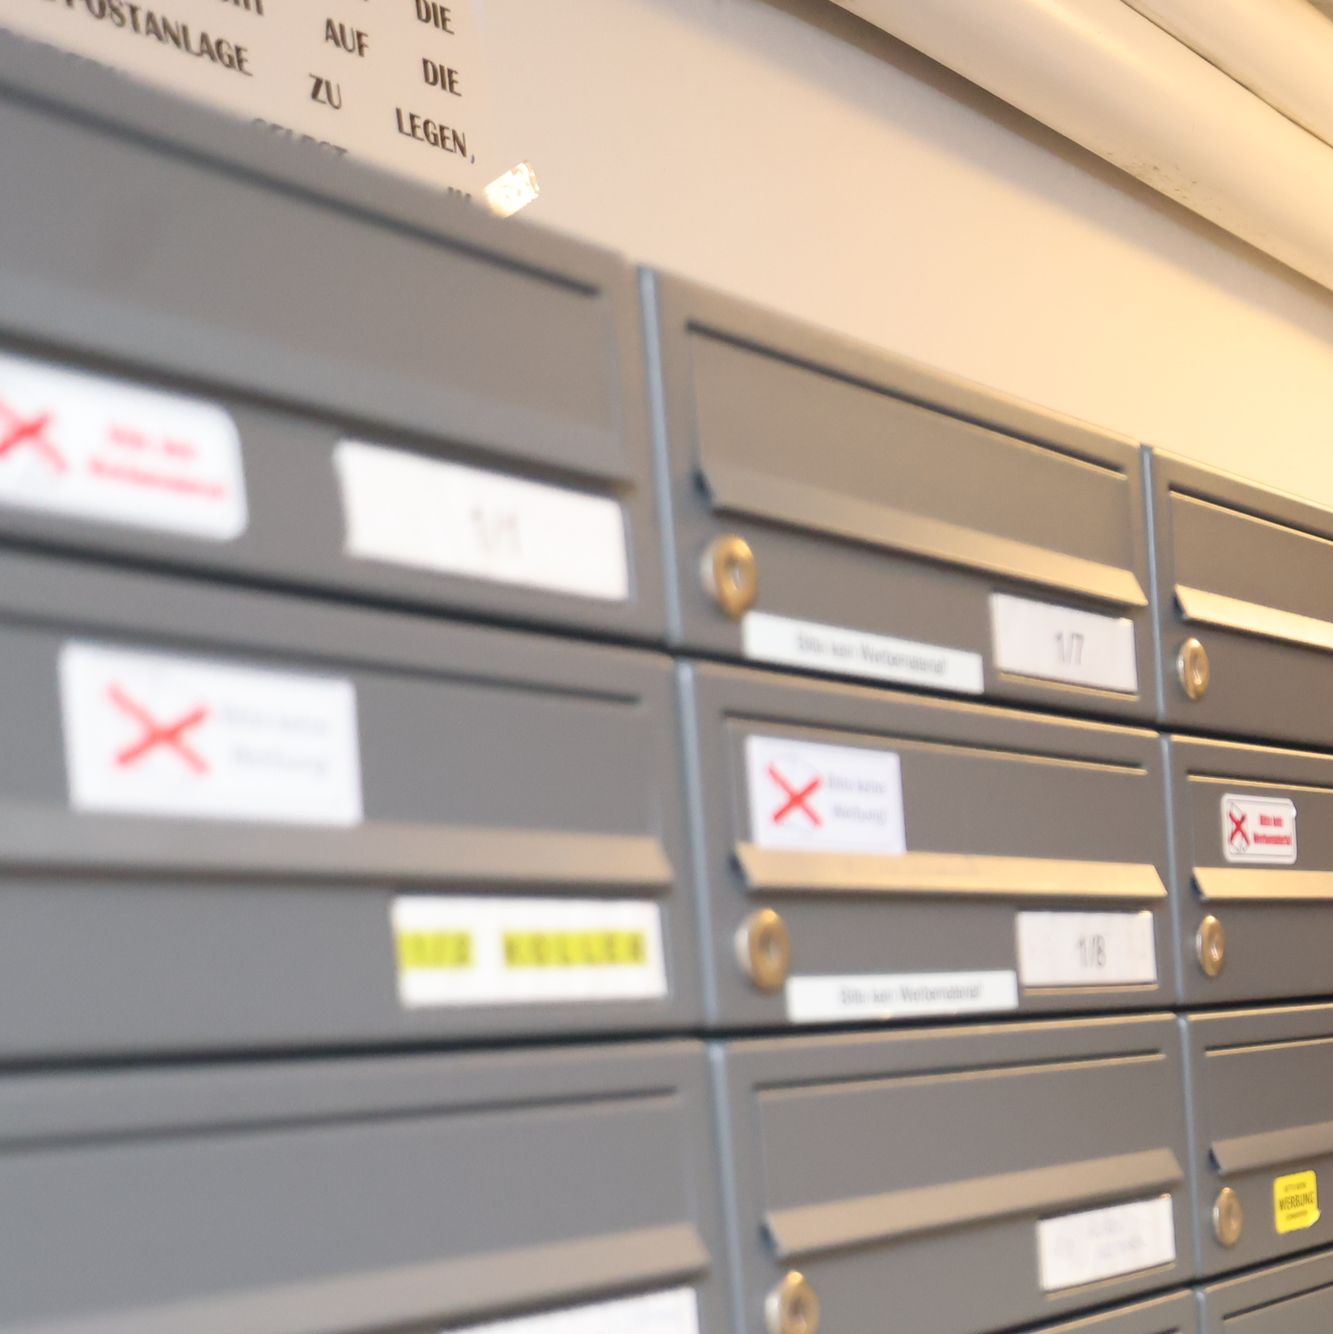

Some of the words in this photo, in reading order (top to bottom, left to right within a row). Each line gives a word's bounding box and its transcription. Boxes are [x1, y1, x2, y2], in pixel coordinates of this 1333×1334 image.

[416, 0, 456, 34] DIE
[324, 17, 370, 57] AUF
[422, 57, 463, 97] DIE
[64, 0, 254, 77] OSTANLAGE
[309, 73, 343, 110] ZU
[395, 107, 477, 165] LEGEN,
[1053, 629, 1085, 667] 1/7
[1076, 934, 1107, 967] 1/8
